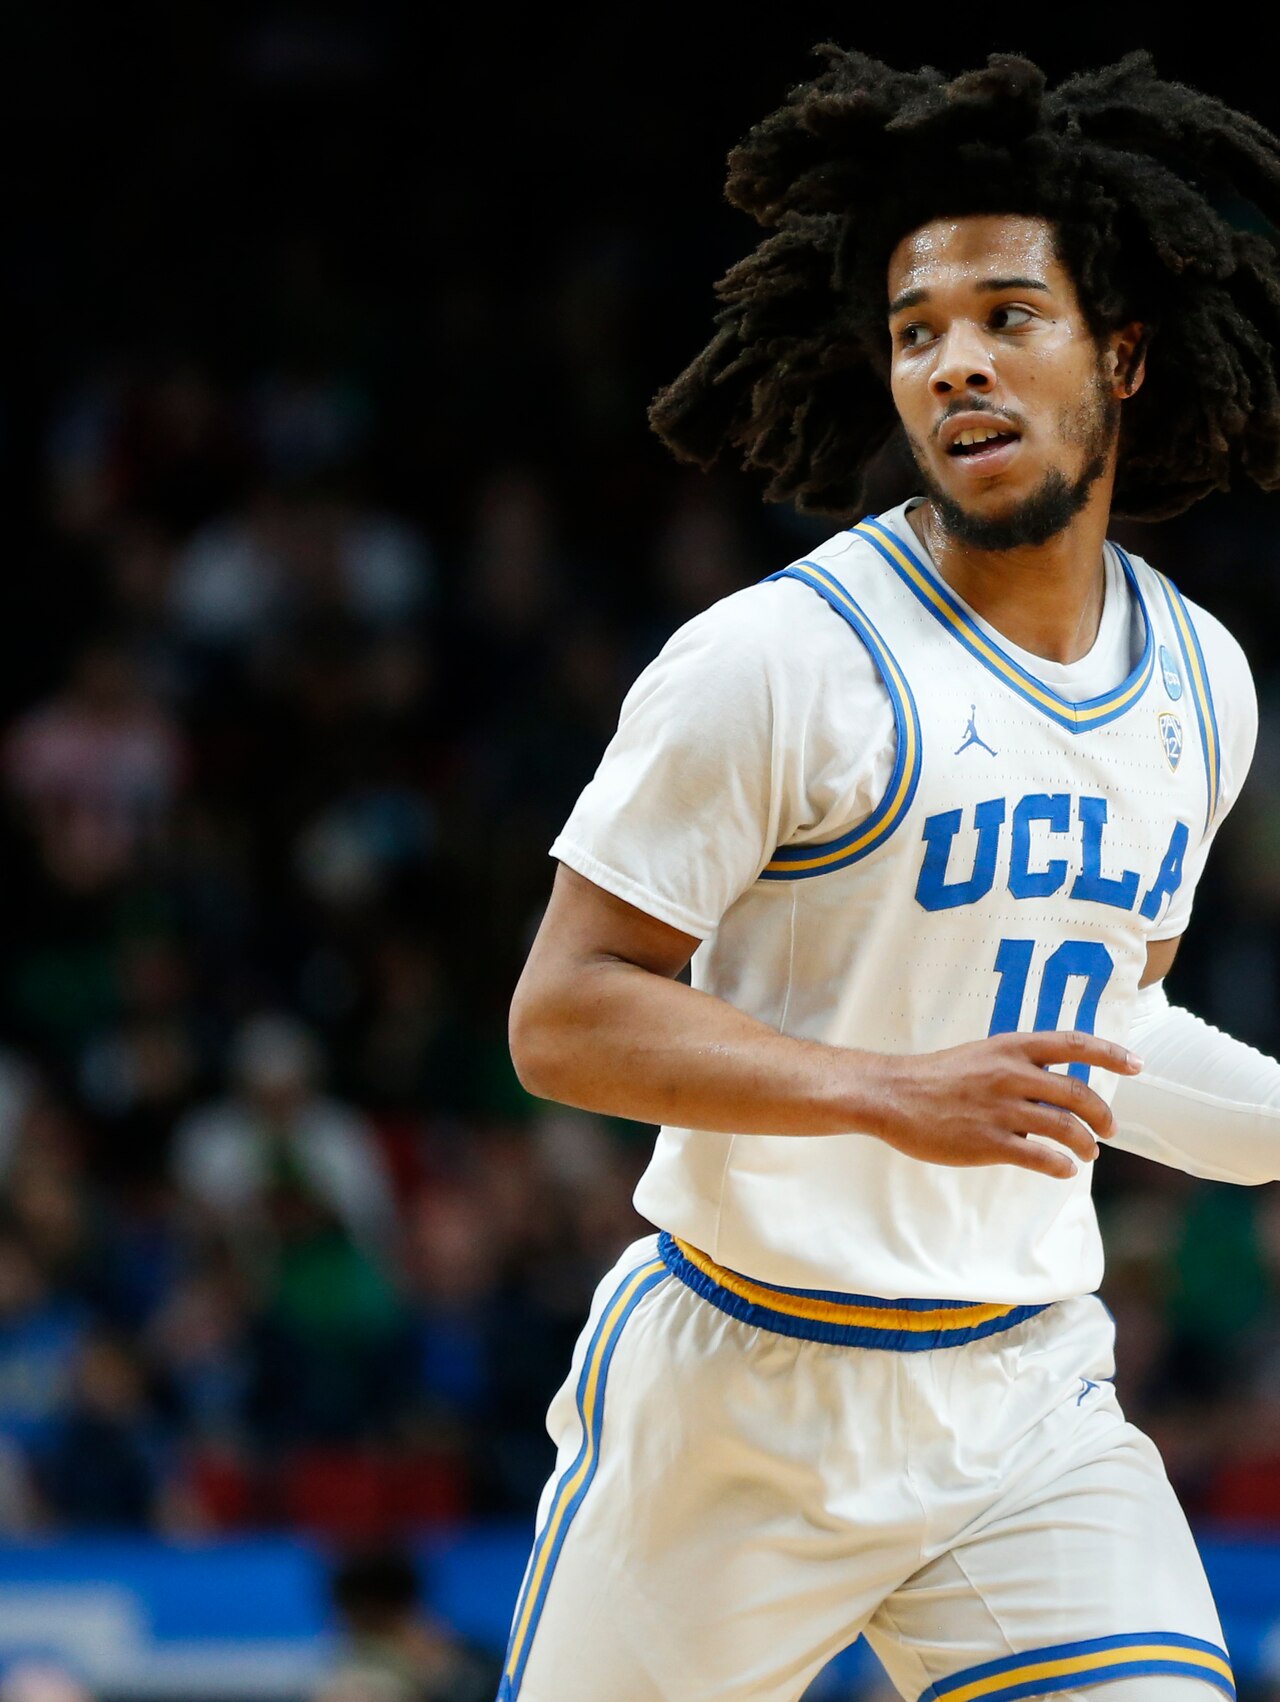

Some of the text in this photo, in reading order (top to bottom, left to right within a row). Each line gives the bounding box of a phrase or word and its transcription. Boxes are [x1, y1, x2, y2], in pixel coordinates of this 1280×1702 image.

[1164, 736, 1179, 758] 12
[914, 794, 1189, 921] UCLA
[987, 939, 1114, 1090] 10
